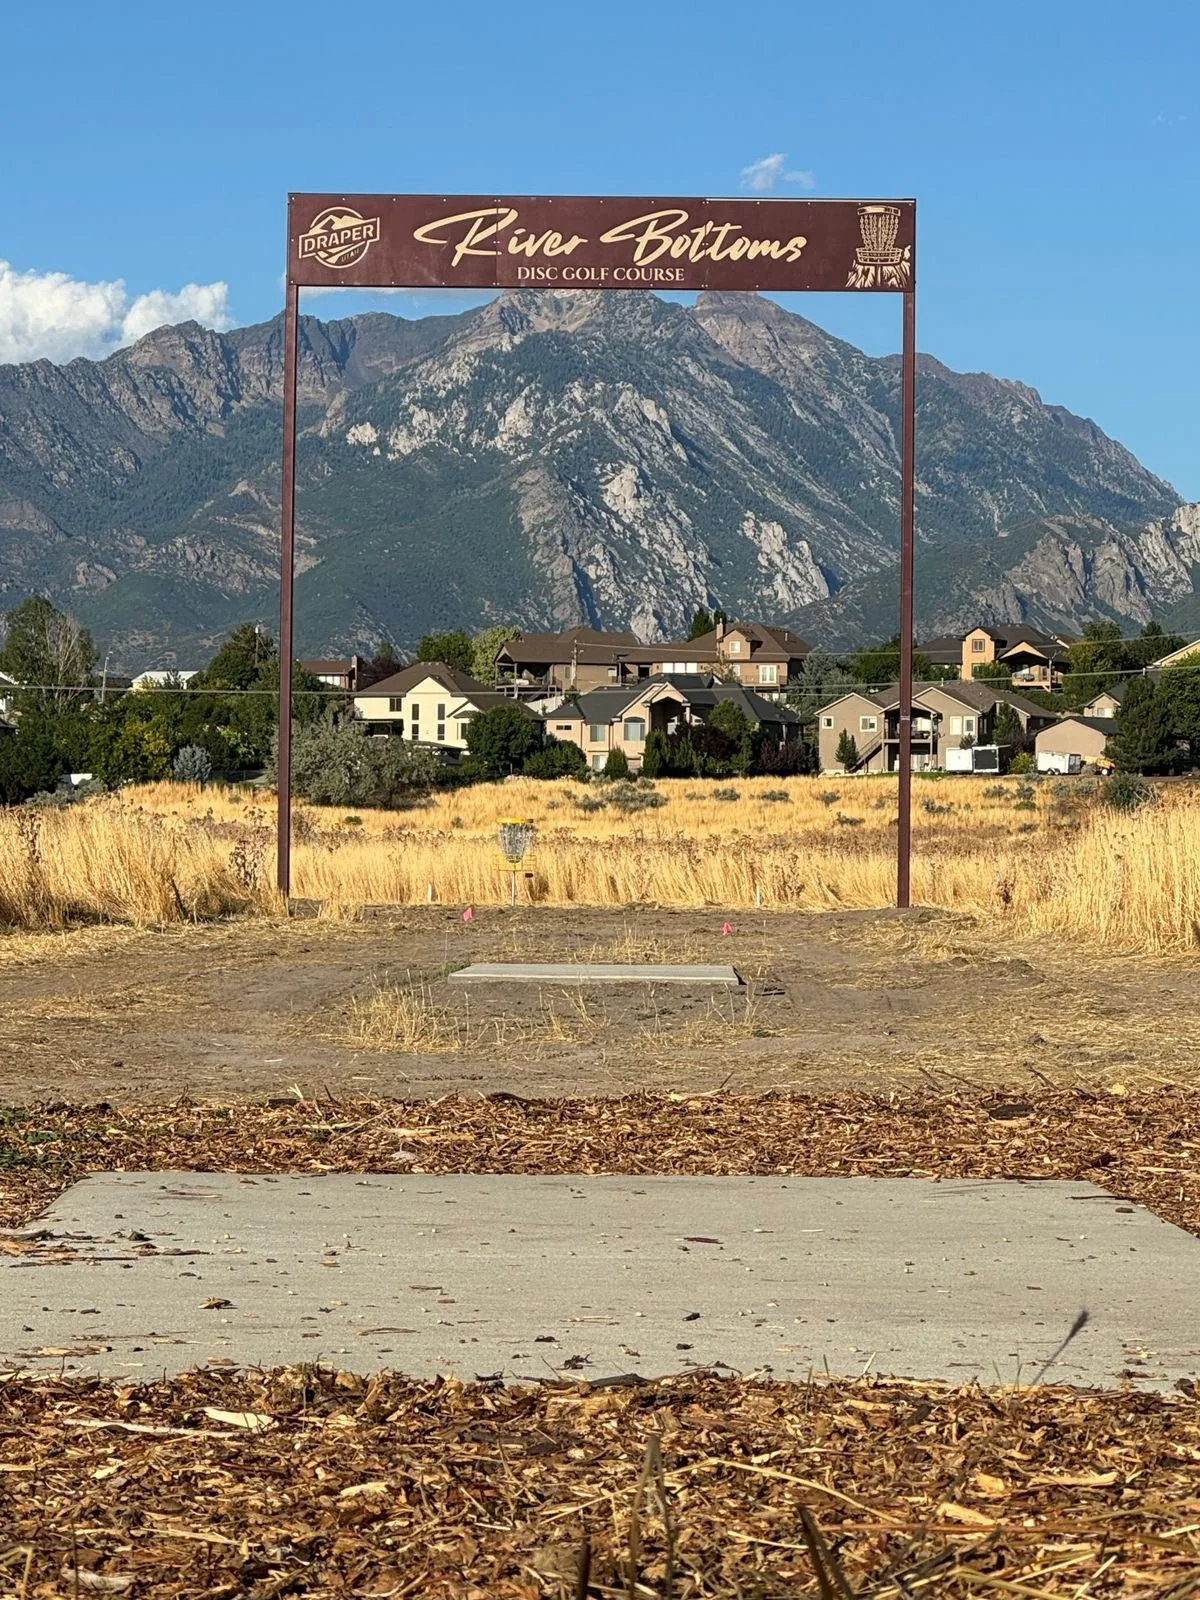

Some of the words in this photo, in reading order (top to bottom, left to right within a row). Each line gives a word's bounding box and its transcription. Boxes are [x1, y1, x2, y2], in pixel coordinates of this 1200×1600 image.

[303, 224, 375, 253] DRAPER
[413, 207, 588, 267] River
[600, 209, 807, 266] Bottoms
[516, 265, 557, 281] DISC
[562, 266, 609, 282] GOLF
[612, 267, 684, 282] COURSE
